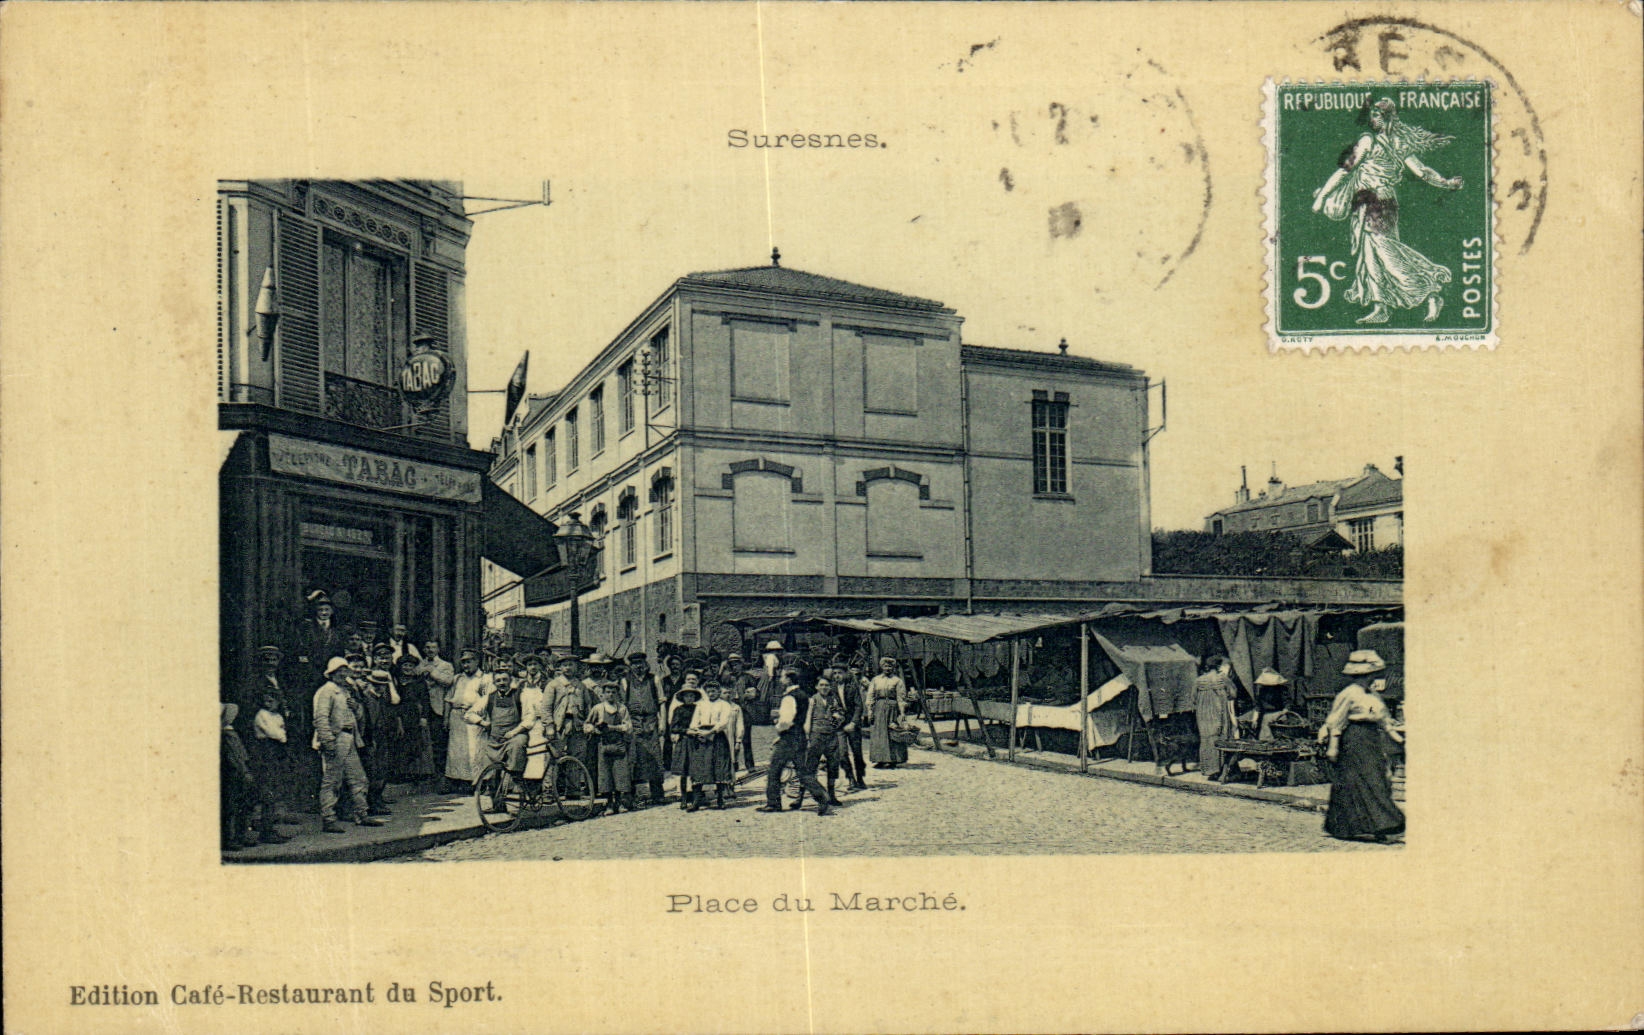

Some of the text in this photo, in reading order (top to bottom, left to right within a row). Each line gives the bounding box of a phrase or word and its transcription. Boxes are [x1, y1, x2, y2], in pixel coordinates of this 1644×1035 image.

[1399, 90, 1482, 112] FRANÇAISE
[1462, 236, 1483, 319] POSTES
[401, 361, 441, 392] TABAC
[342, 453, 417, 489] TABAC
